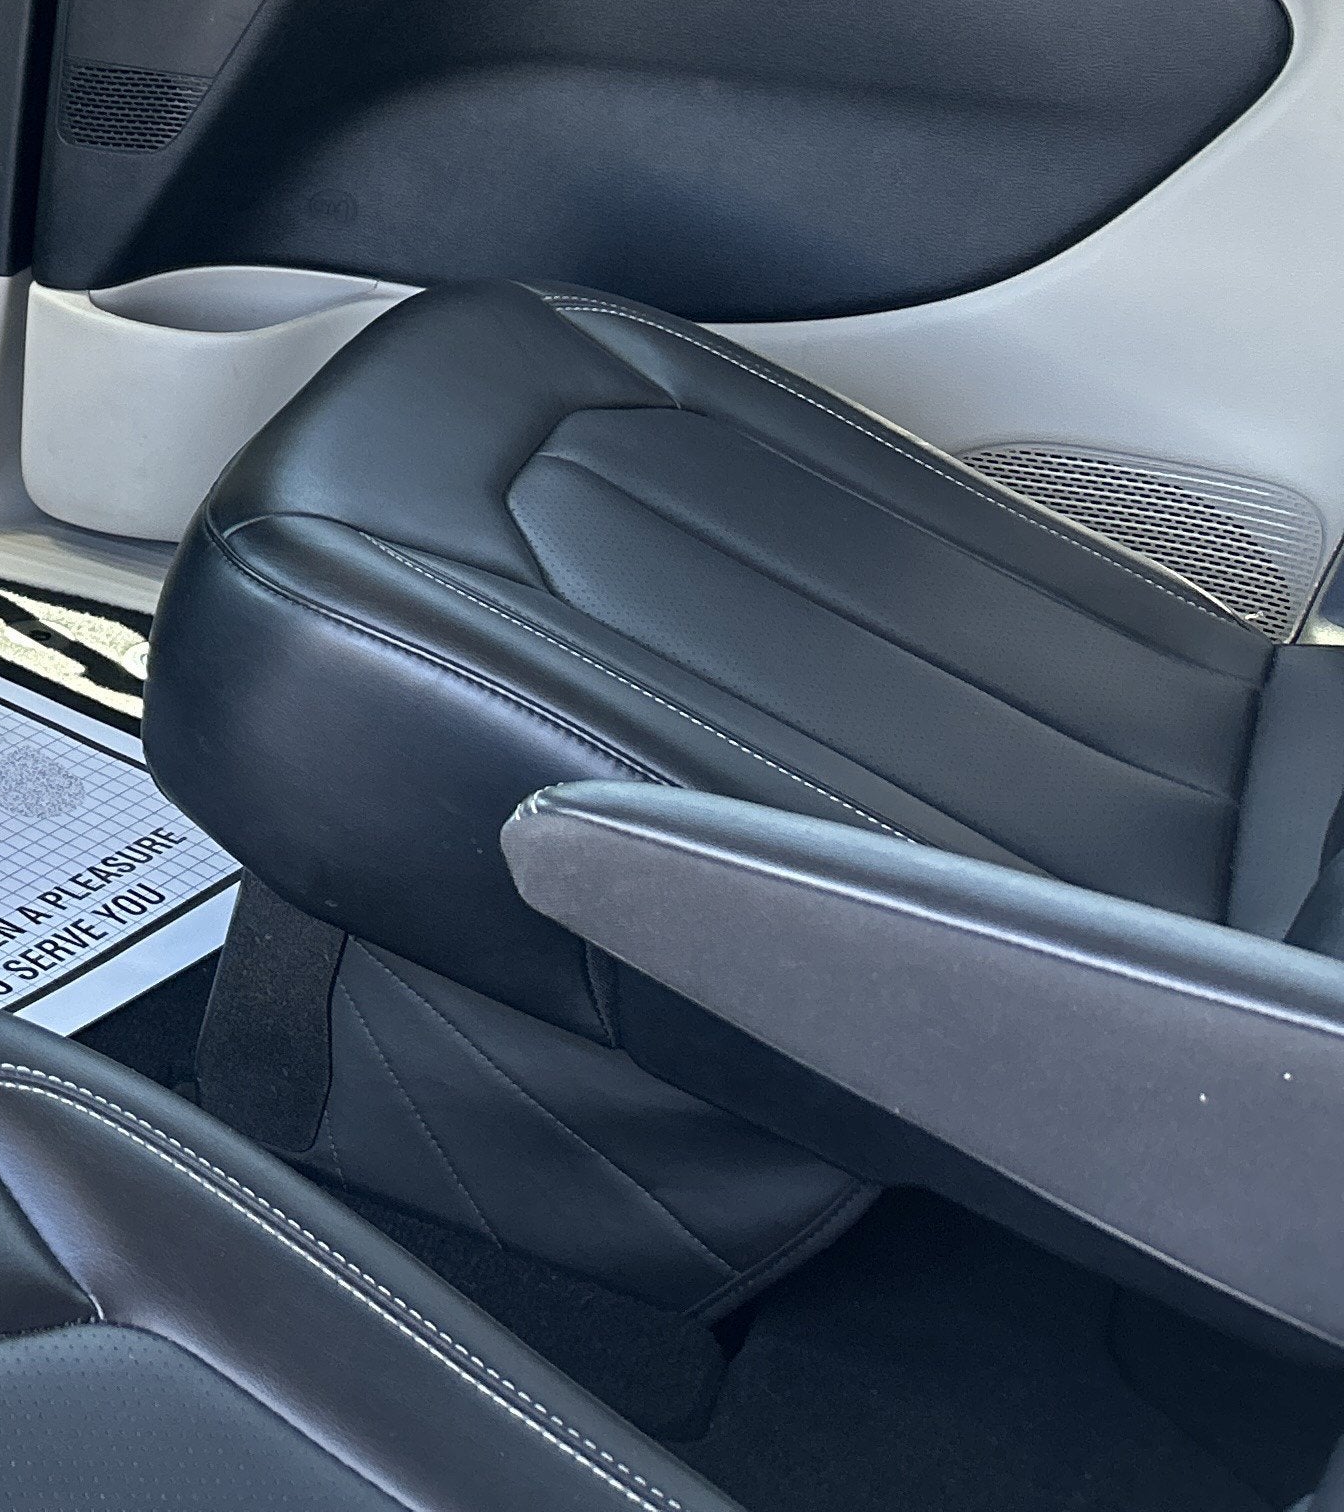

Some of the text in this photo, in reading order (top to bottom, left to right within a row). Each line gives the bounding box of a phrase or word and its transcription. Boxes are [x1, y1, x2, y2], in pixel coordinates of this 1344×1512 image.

[16, 905, 54, 925] A
[36, 826, 188, 911] PLEASURE
[2, 918, 109, 980] SERVE
[92, 882, 166, 925] YOU
